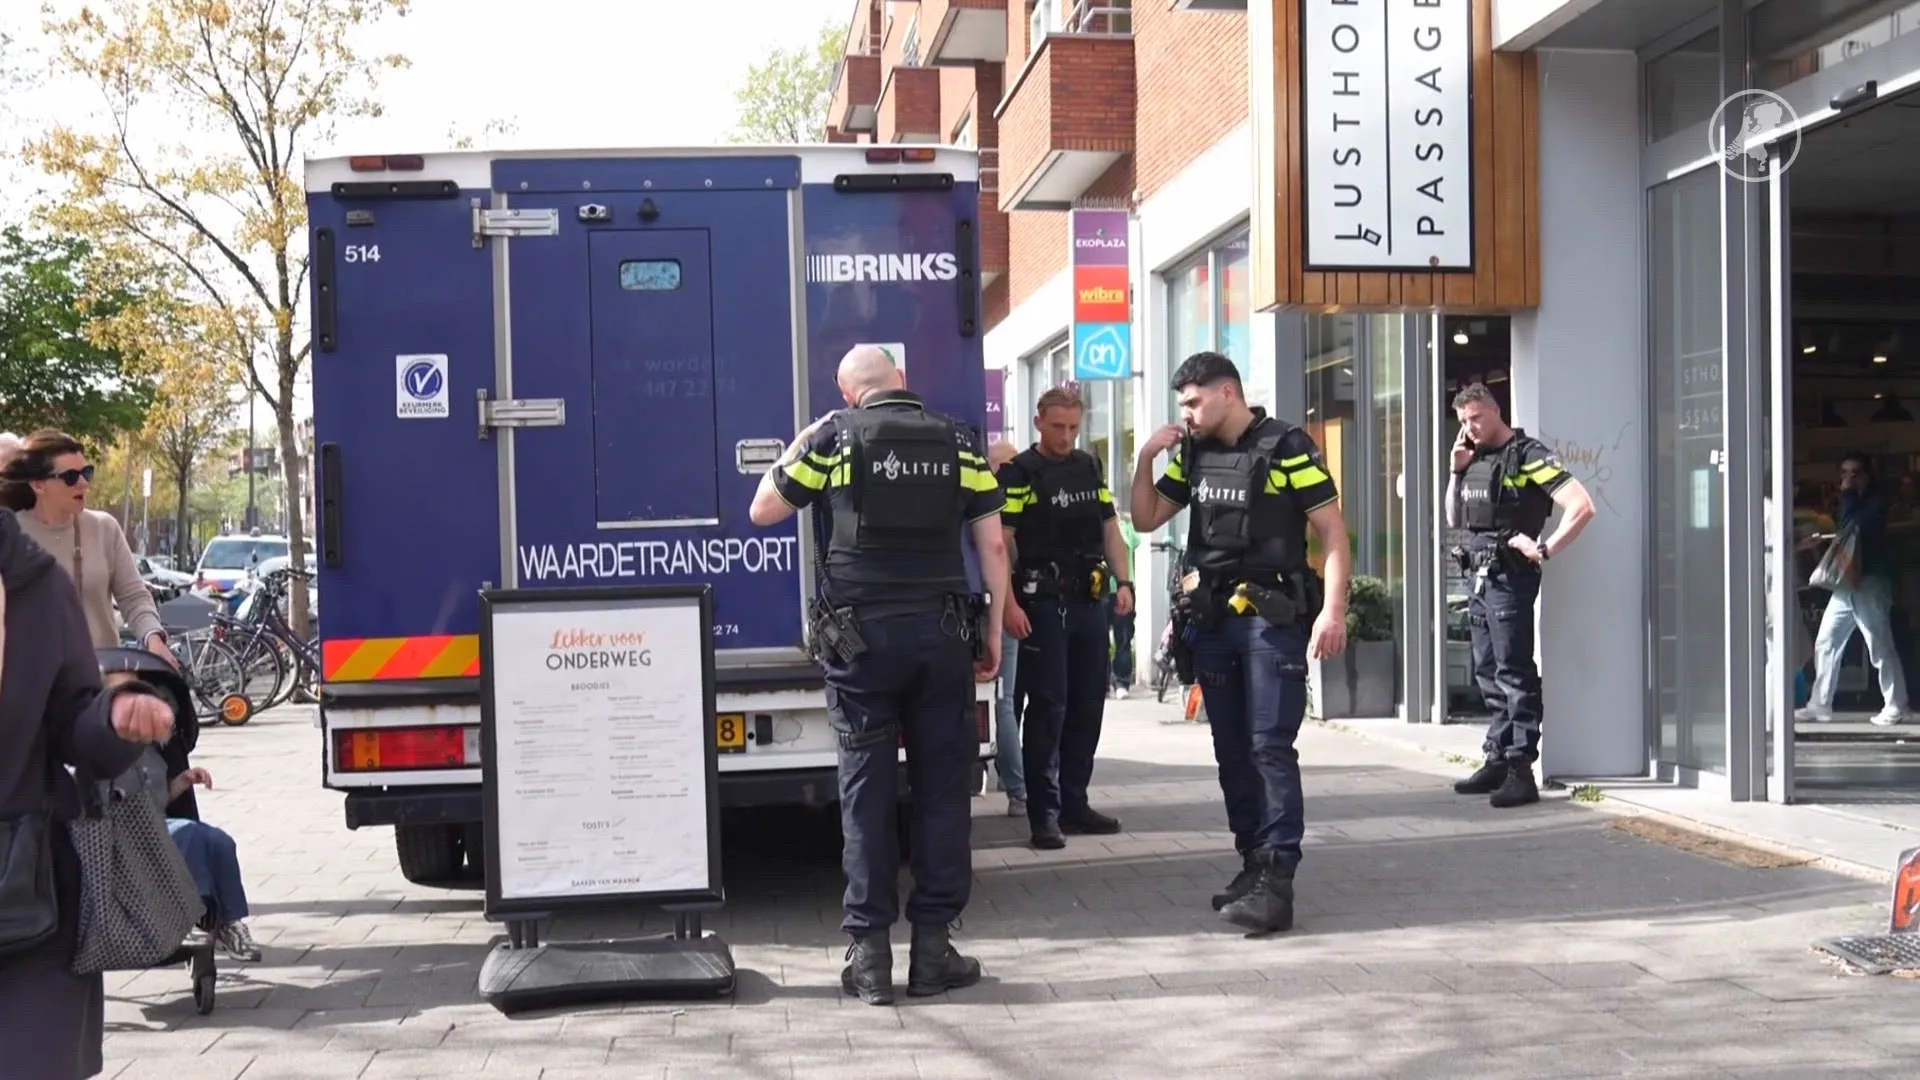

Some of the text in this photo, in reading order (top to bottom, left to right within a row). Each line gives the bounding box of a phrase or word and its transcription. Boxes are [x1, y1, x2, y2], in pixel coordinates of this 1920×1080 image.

[1075, 237, 1126, 248] EKOPLAZA
[345, 244, 381, 263] 514
[831, 252, 958, 282] BRINKS
[1079, 286, 1125, 302] wibra
[520, 536, 796, 580] WAARDETRANSPORT
[550, 627, 646, 649] Lekker voor
[726, 624, 739, 635] 74
[546, 649, 652, 670] ONDERWEG
[720, 719, 736, 742] 8
